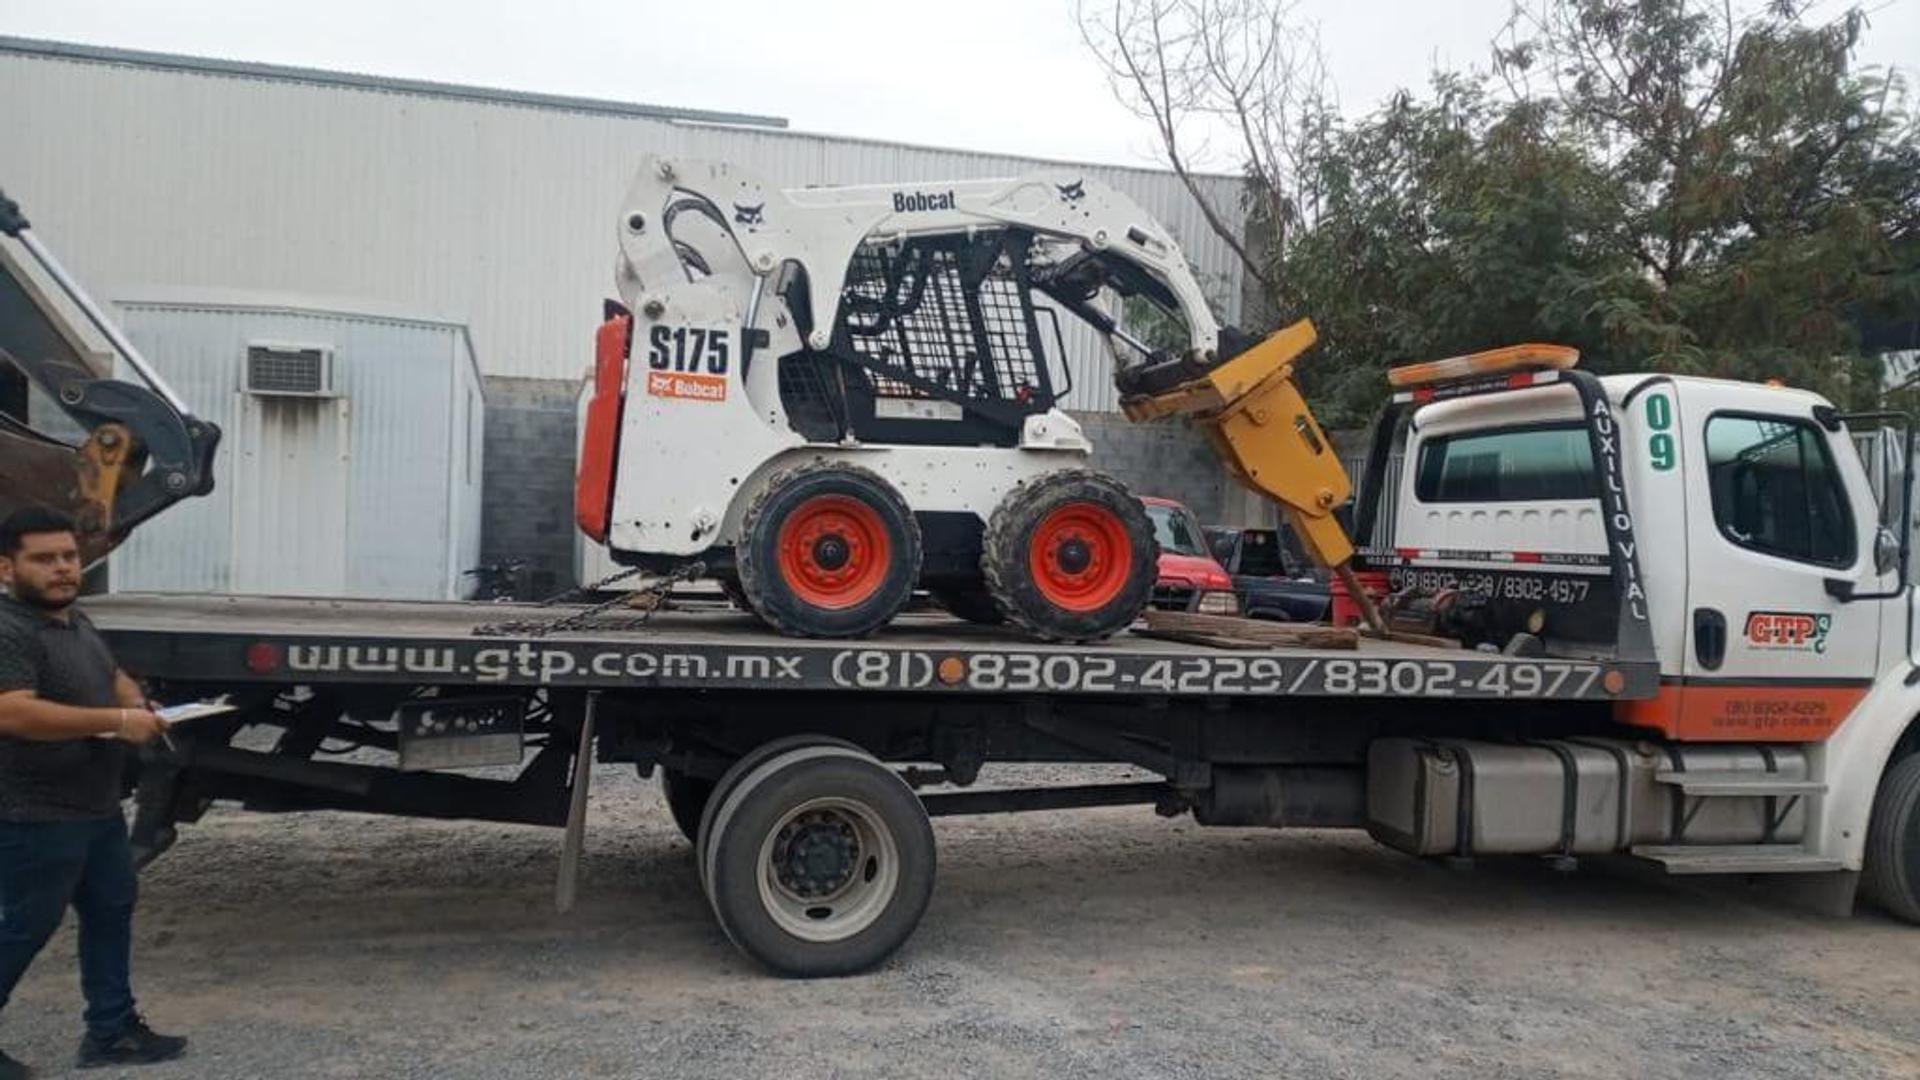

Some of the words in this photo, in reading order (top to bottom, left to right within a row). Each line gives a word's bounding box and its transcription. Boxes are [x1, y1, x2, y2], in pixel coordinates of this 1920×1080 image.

[893, 189, 956, 213] Bobcat
[649, 325, 728, 374] S175
[674, 379, 724, 398] Bobcat
[1594, 399, 1631, 531] AUXILIO
[1619, 541, 1646, 619] VIAL
[1749, 614, 1816, 646] GTP
[288, 643, 803, 683] www.gtp.com.mx
[832, 650, 934, 687] (81)
